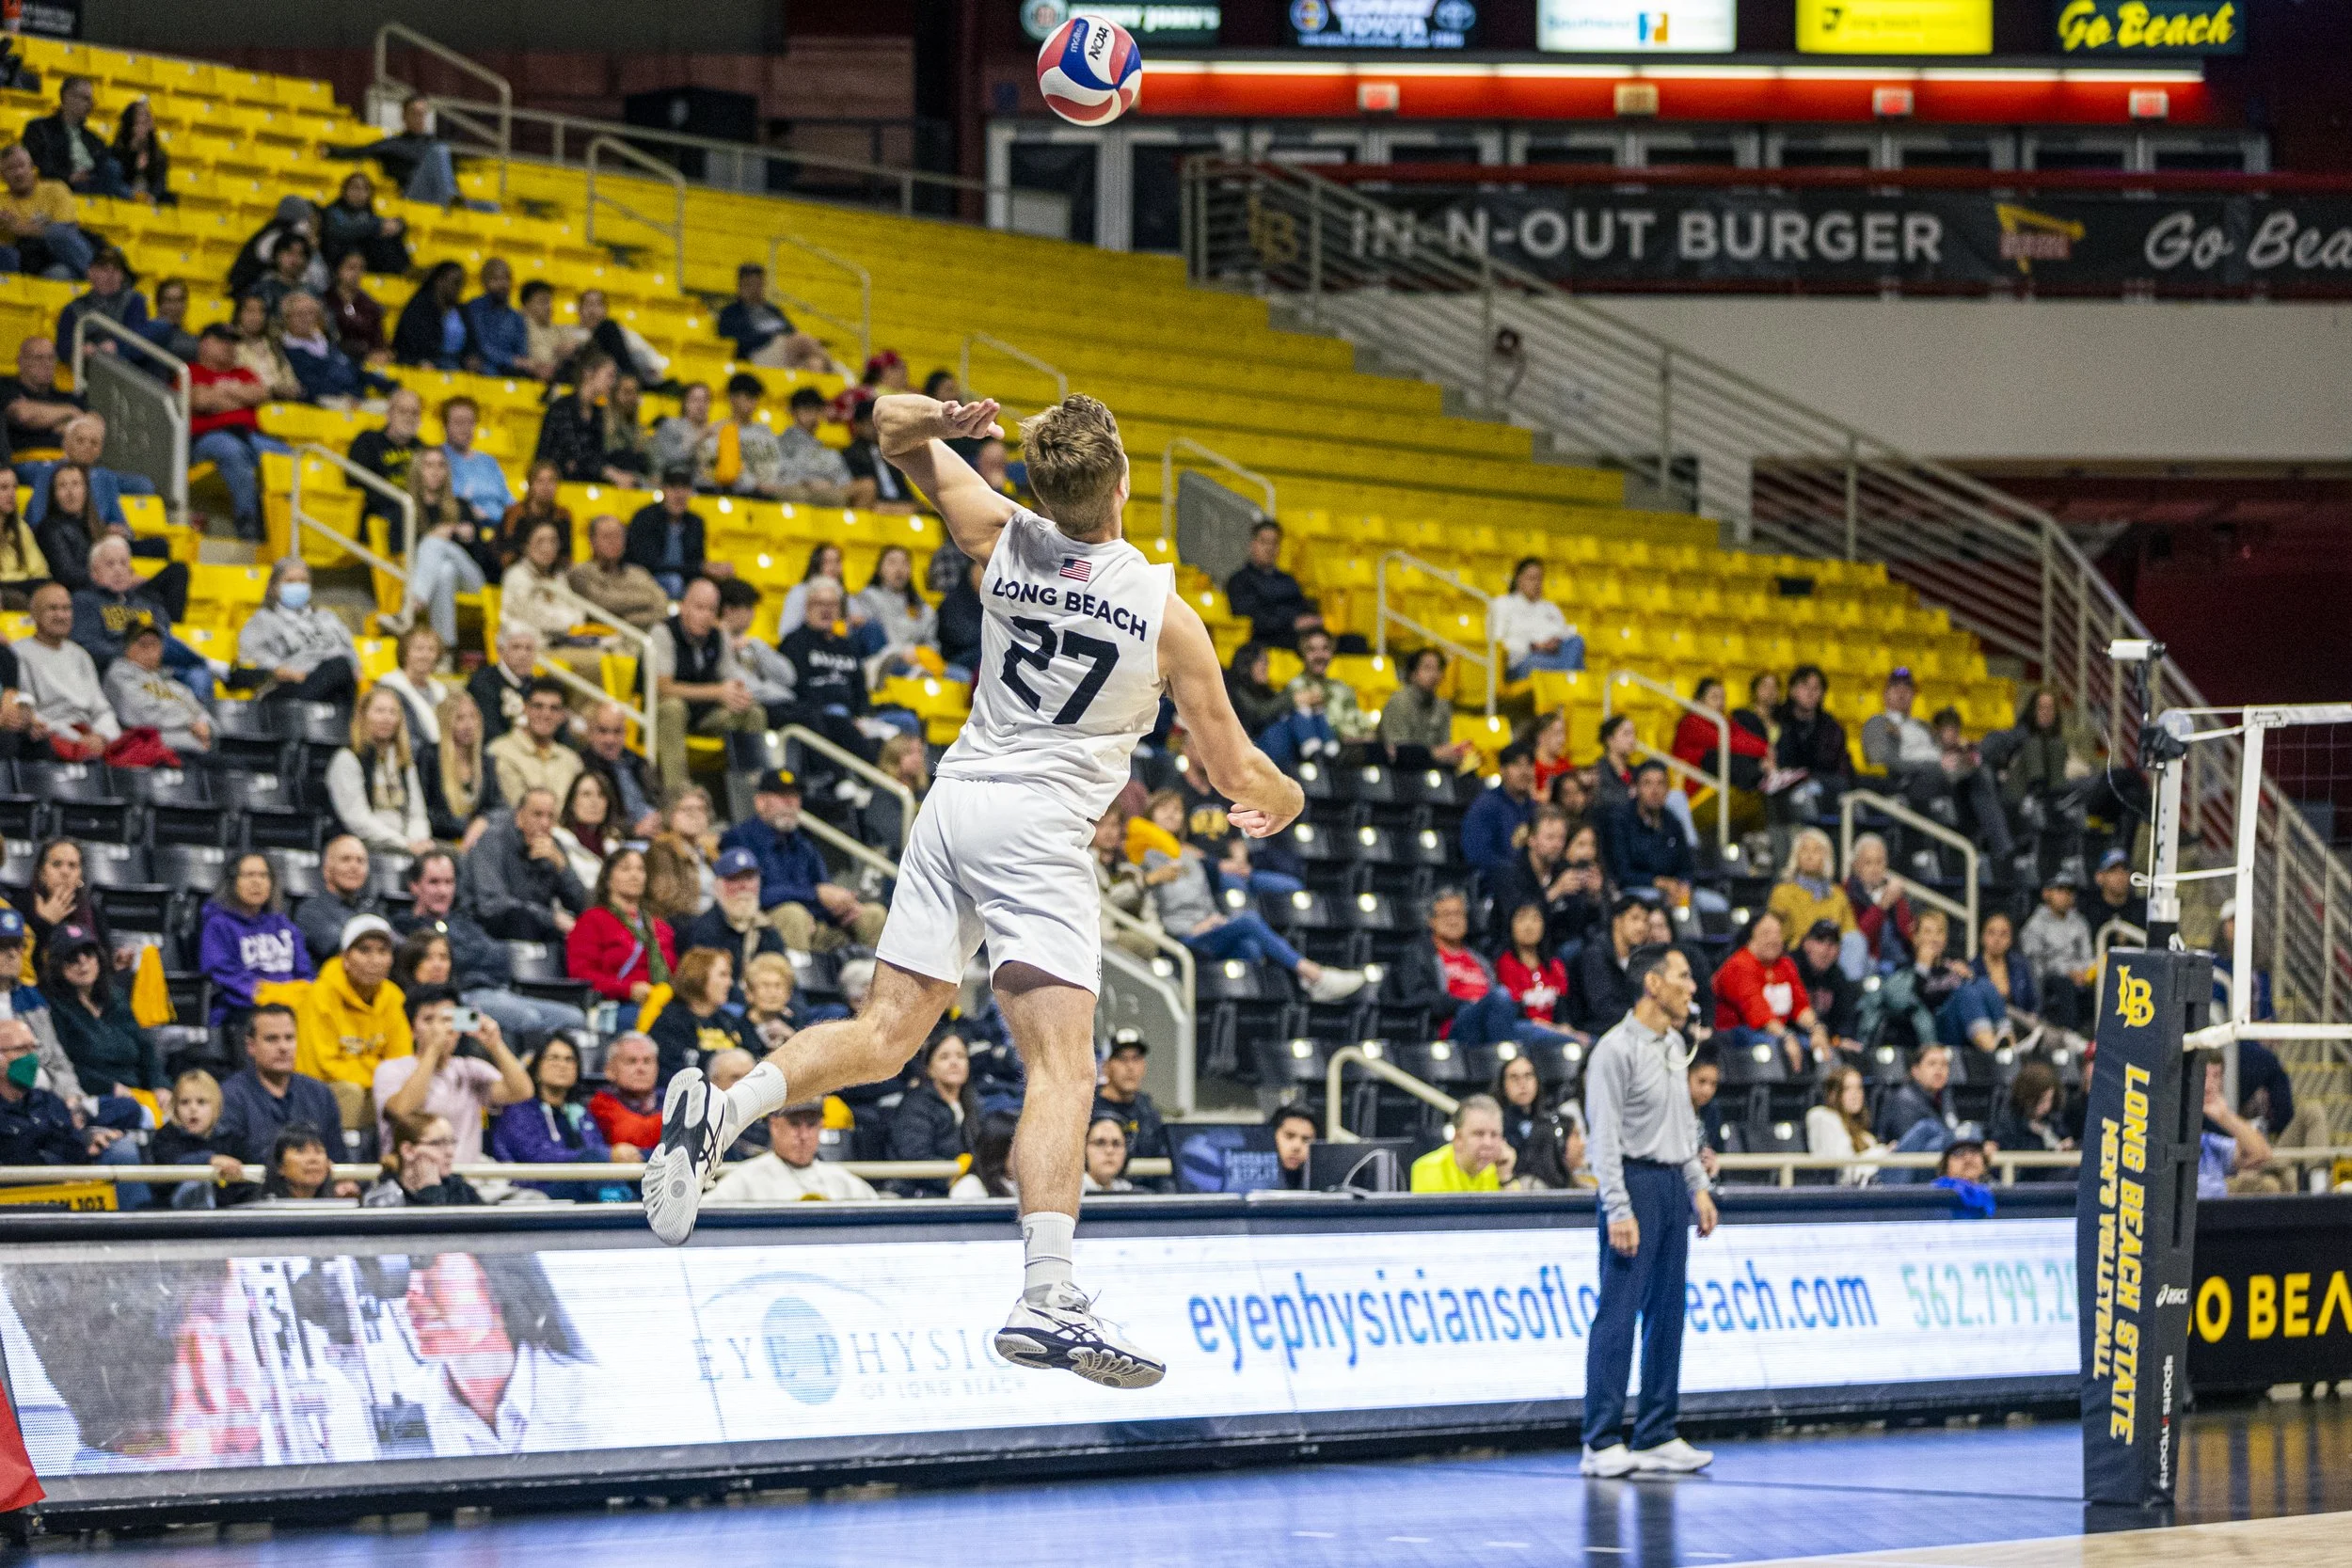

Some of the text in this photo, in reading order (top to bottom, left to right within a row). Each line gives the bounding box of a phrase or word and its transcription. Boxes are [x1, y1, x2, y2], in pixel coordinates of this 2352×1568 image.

[1089, 26, 1109, 60] NCAA
[2058, 0, 2235, 51] Go Beach
[1351, 208, 1658, 261] IN-N-OUT
[1677, 209, 1944, 262] BURGER
[2144, 210, 2235, 270] Go
[992, 577, 1148, 642] LONG BEACH
[1000, 615, 1120, 725] 27
[2092, 1117, 2120, 1382] MEN'S VOLLEYBALL
[2109, 1061, 2152, 1447] LONG BEACH STATE
[1187, 1258, 1880, 1373] eyephysiciansofloeach.com
[2187, 1275, 2233, 1344] O
[815, 1327, 1017, 1377] PHYSIC
